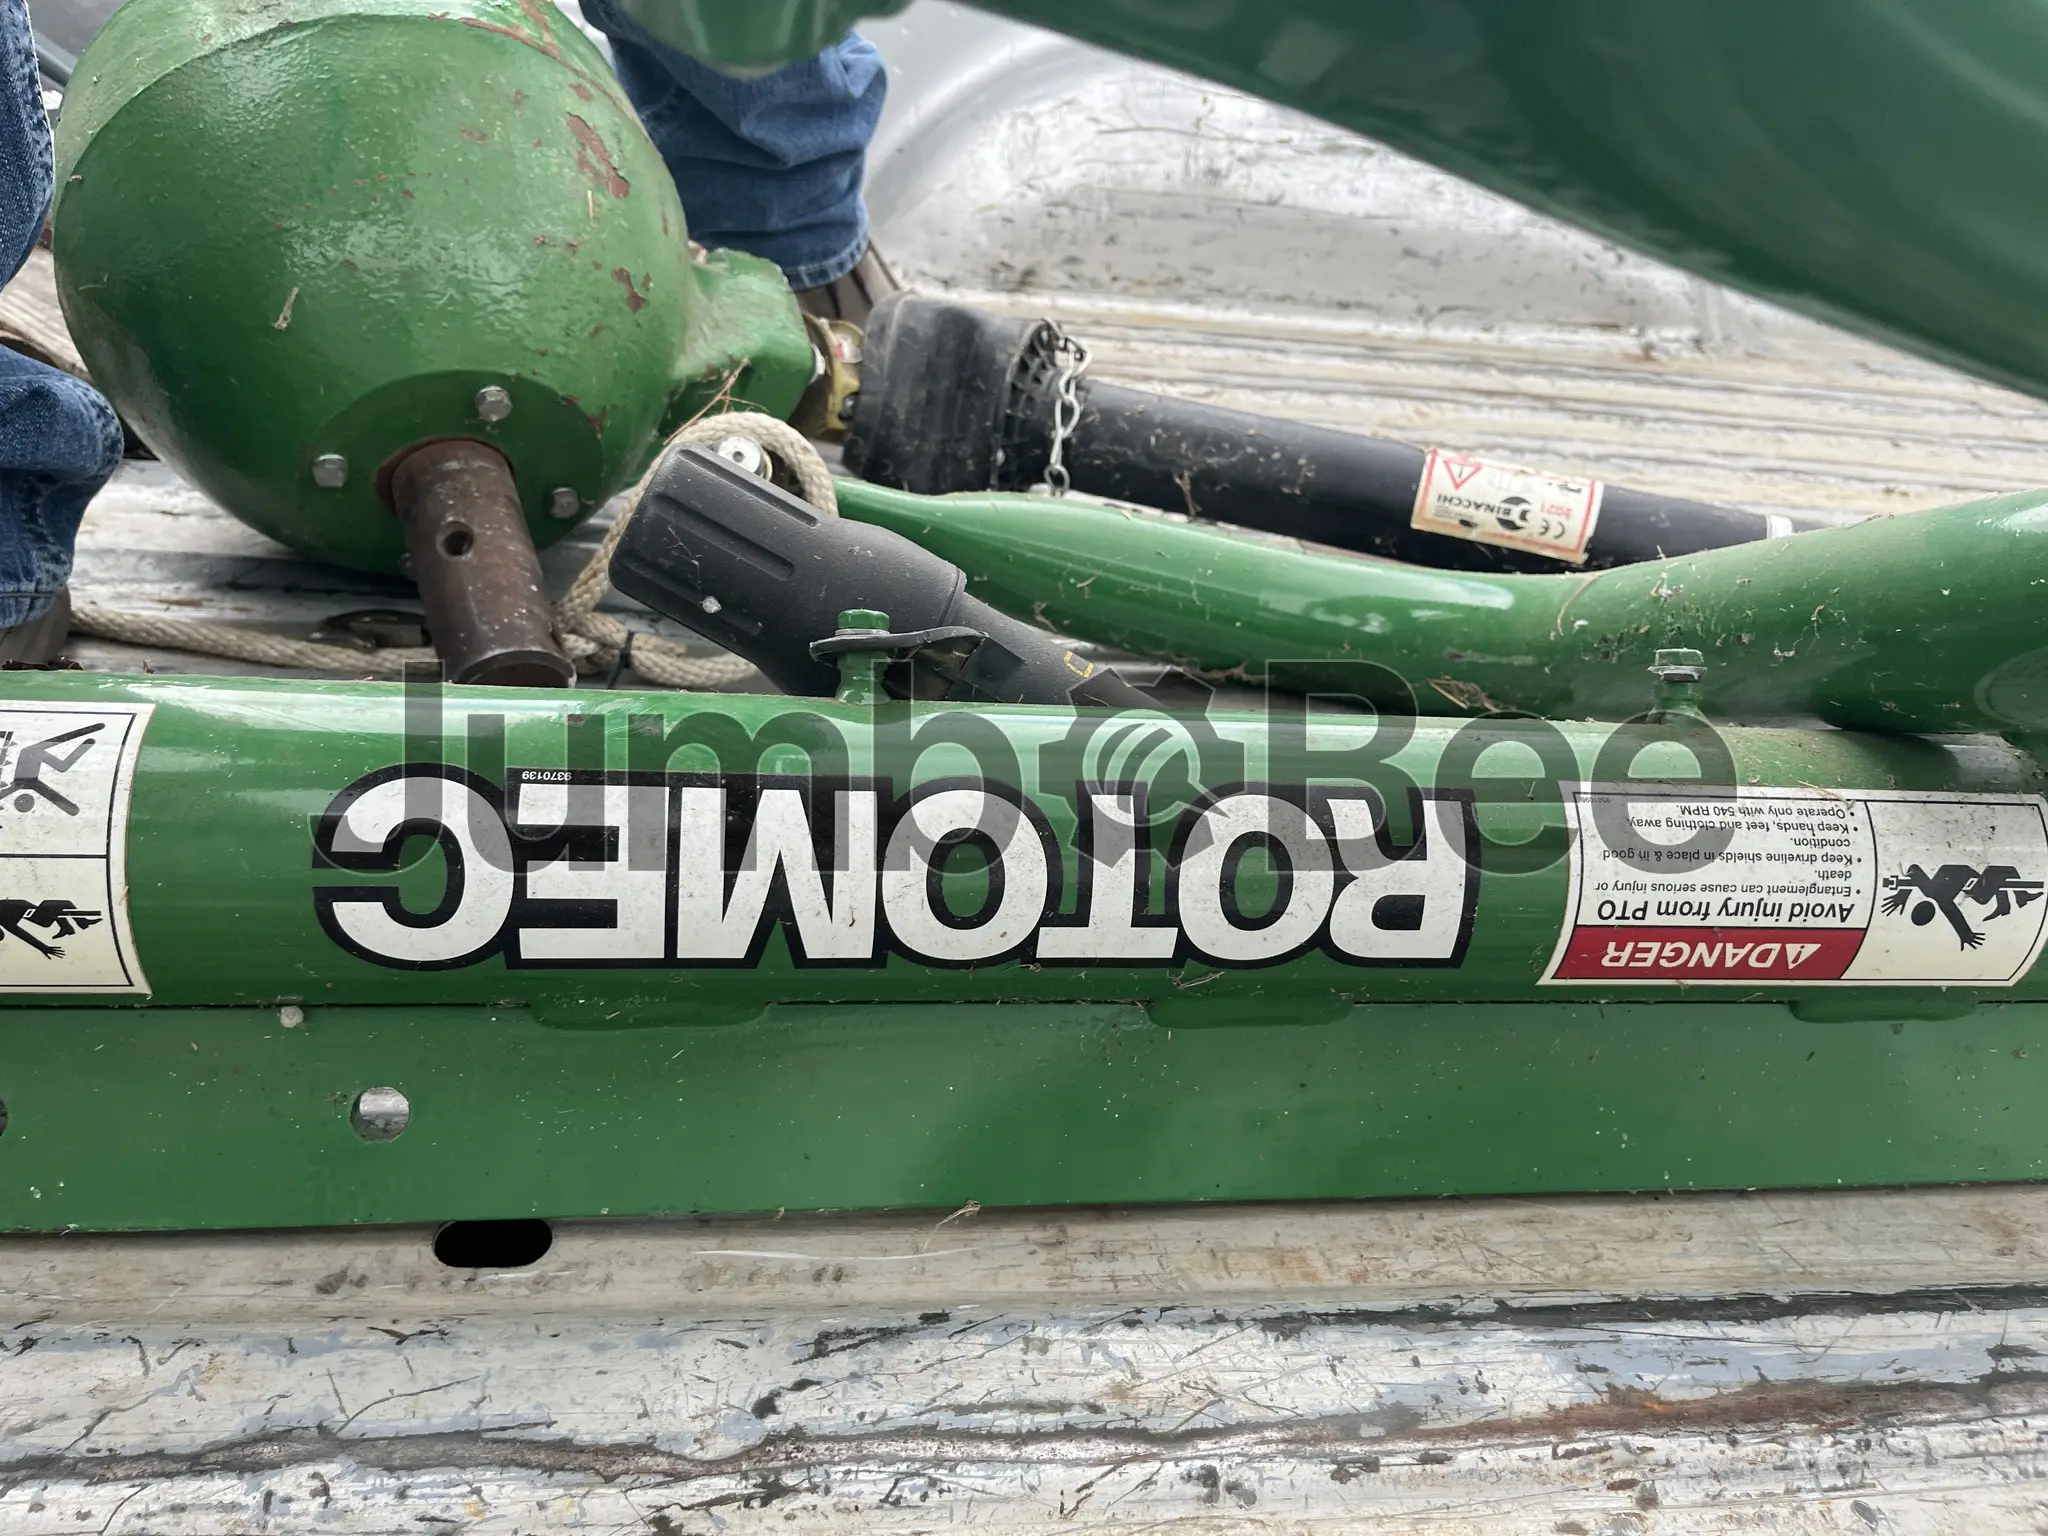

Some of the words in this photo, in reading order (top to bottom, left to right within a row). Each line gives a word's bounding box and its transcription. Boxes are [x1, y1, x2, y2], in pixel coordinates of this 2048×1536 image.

[522, 770, 572, 781] 9370139
[1676, 805, 1709, 816] RPM.
[1713, 806, 1735, 816] 540
[1738, 807, 1761, 817] with
[1768, 805, 1792, 817] only
[1797, 807, 1845, 819] Operate
[1626, 816, 1662, 827] away.
[1665, 818, 1715, 830] clothing
[1719, 821, 1741, 831] and
[1746, 821, 1770, 832] feet
[1772, 820, 1814, 833] hands,
[1817, 822, 1849, 834] Keep
[1790, 837, 1850, 849] condition.
[1603, 848, 1635, 860] good
[1638, 850, 1650, 861] in
[1654, 851, 1662, 862] &
[1667, 850, 1700, 862] place
[1704, 852, 1714, 863] in
[1718, 852, 1762, 864] shields
[1766, 853, 1817, 864] driveline
[1821, 852, 1852, 865] Keep
[328, 774, 1468, 964] ROTOMEC
[1814, 869, 1852, 881] death.
[1596, 882, 1608, 892] or
[1612, 881, 1647, 894] injury
[1651, 883, 1696, 894] serious
[1701, 883, 1737, 894] cause
[1740, 884, 1763, 894] can
[1767, 883, 1852, 896] Entanglement
[1598, 900, 1648, 920] PTO
[1657, 901, 1711, 921] from
[1717, 898, 1783, 922] injury
[1788, 902, 1855, 923] Avoid
[1601, 941, 1781, 968] DANGER
